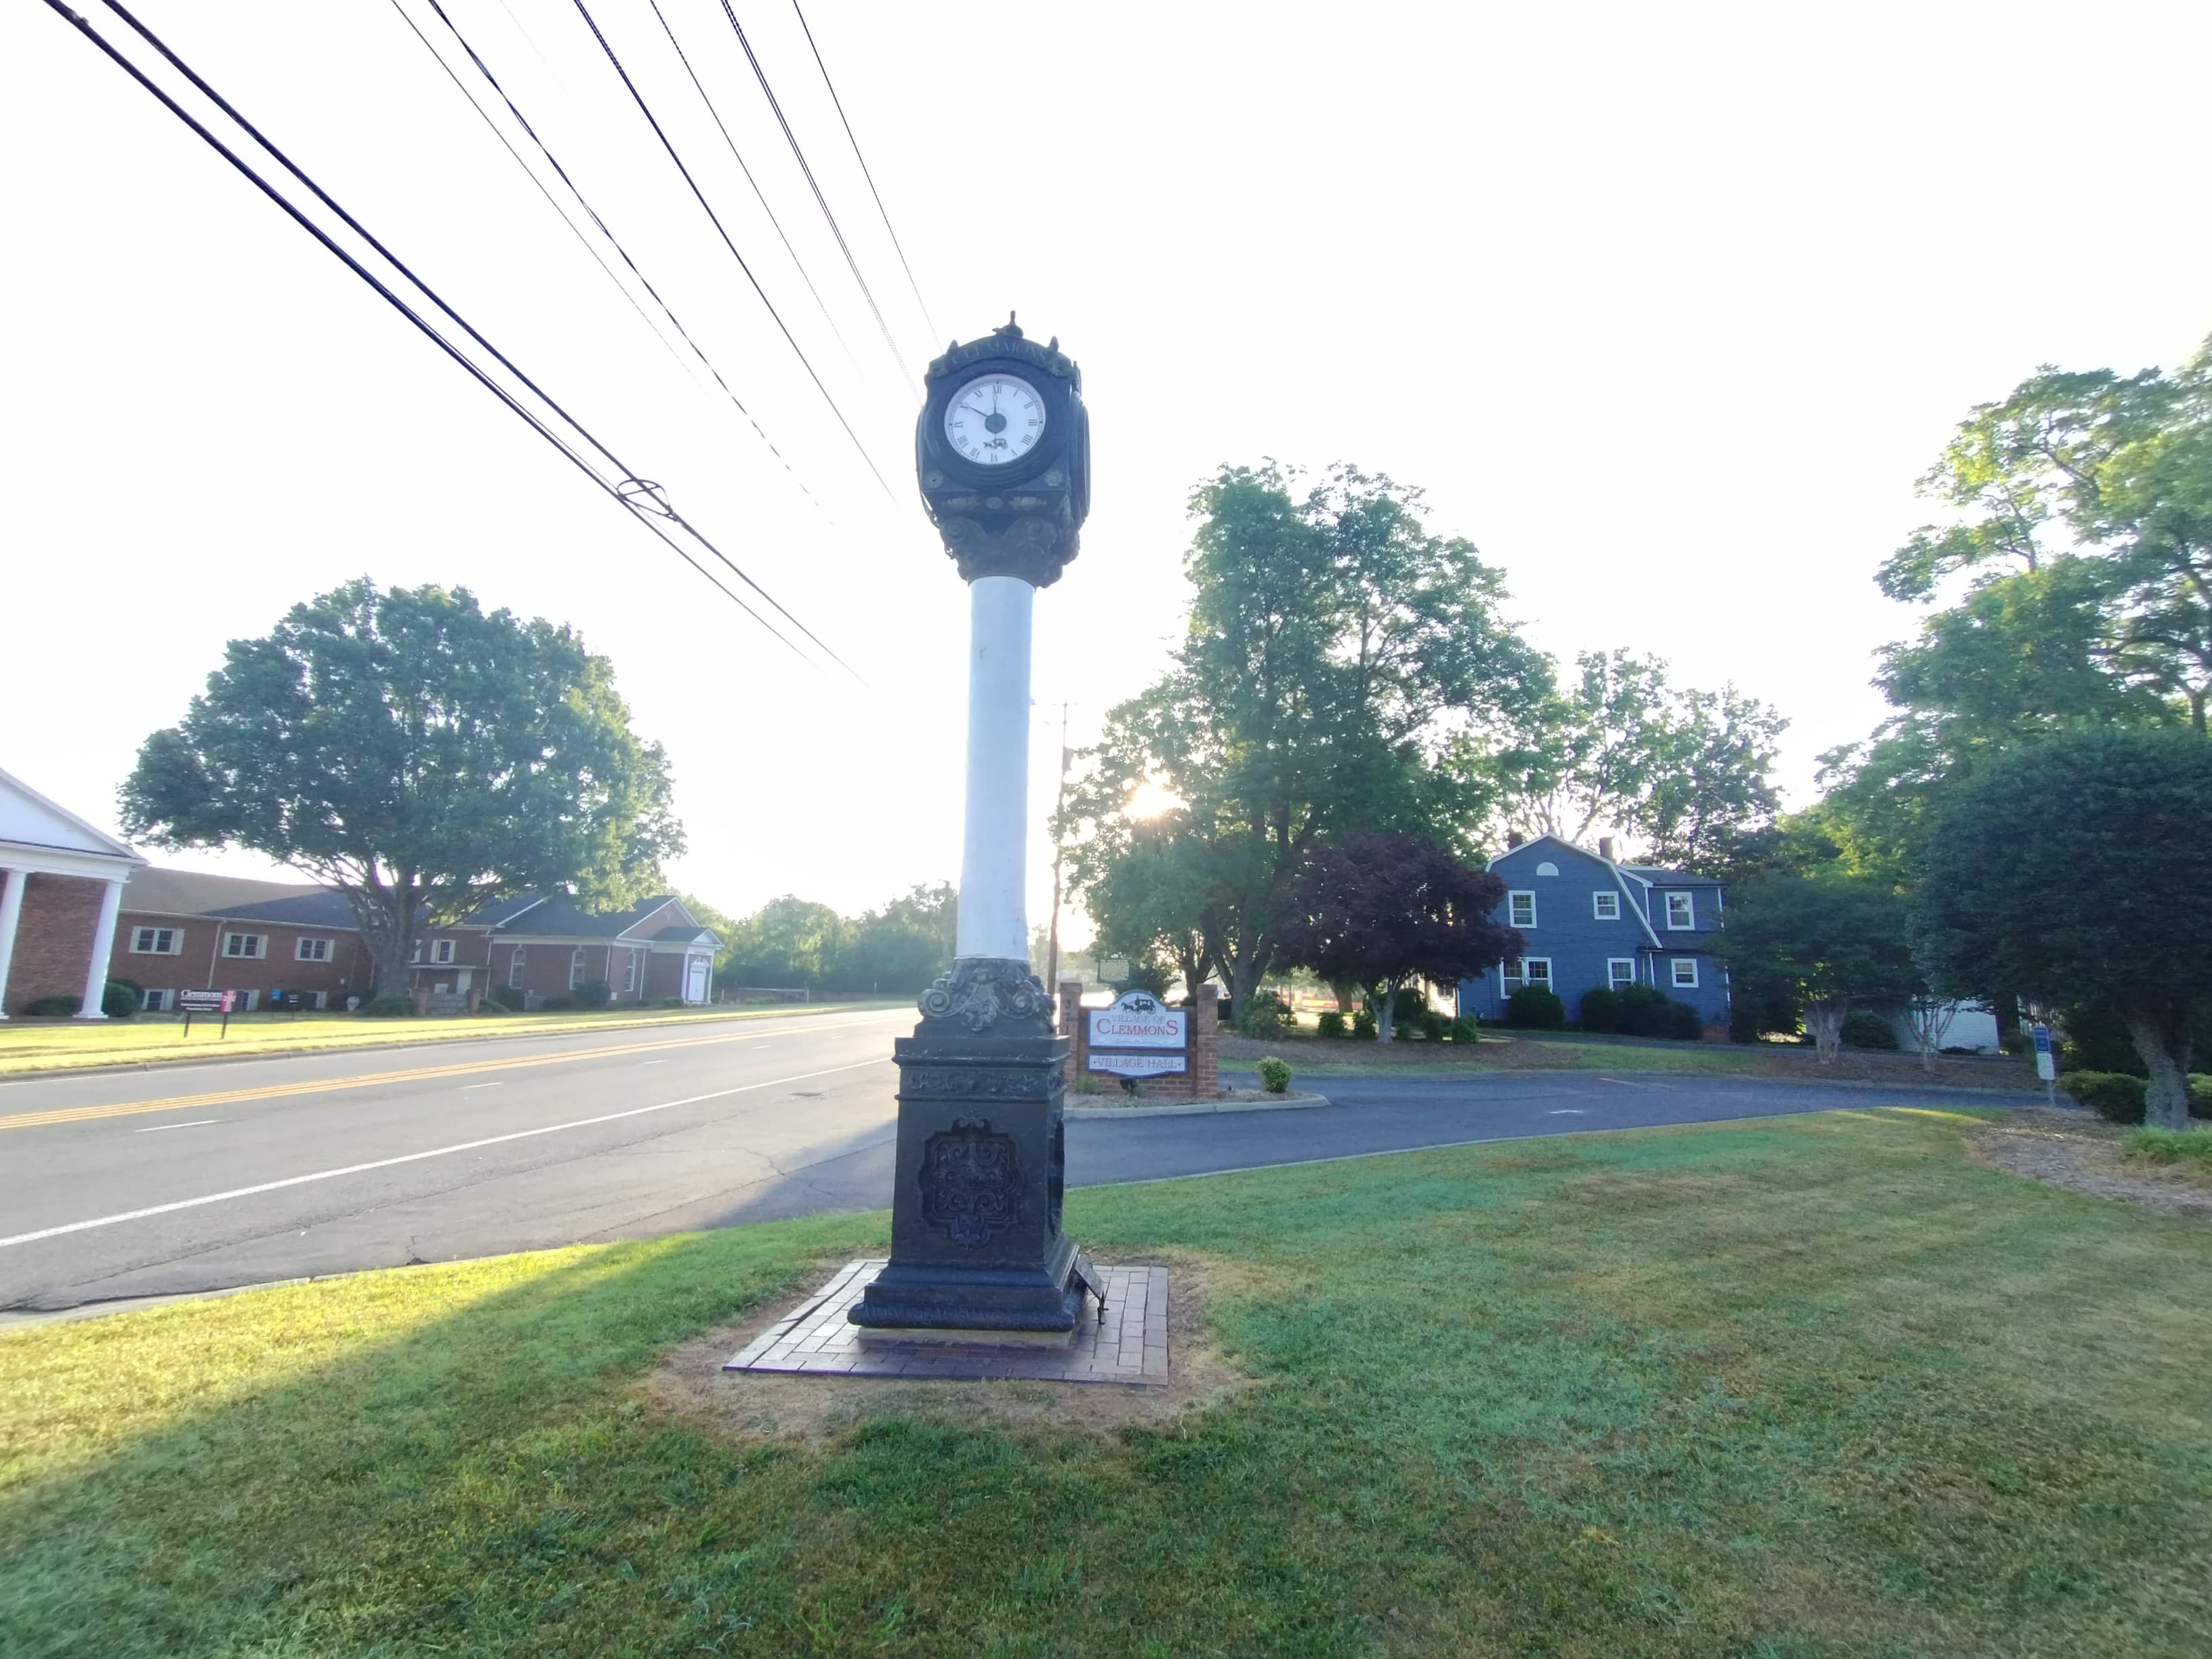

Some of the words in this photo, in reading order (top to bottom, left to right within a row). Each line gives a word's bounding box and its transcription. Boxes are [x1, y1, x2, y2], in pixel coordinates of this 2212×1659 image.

[993, 385, 1002, 394] XII
[1111, 1015, 1150, 1023] VILLAGE
[1153, 1015, 1166, 1023] OF
[1097, 1018, 1179, 1036] CLEMMONS
[1098, 1057, 1144, 1068] VILLAGE
[1147, 1059, 1177, 1069] HALL
